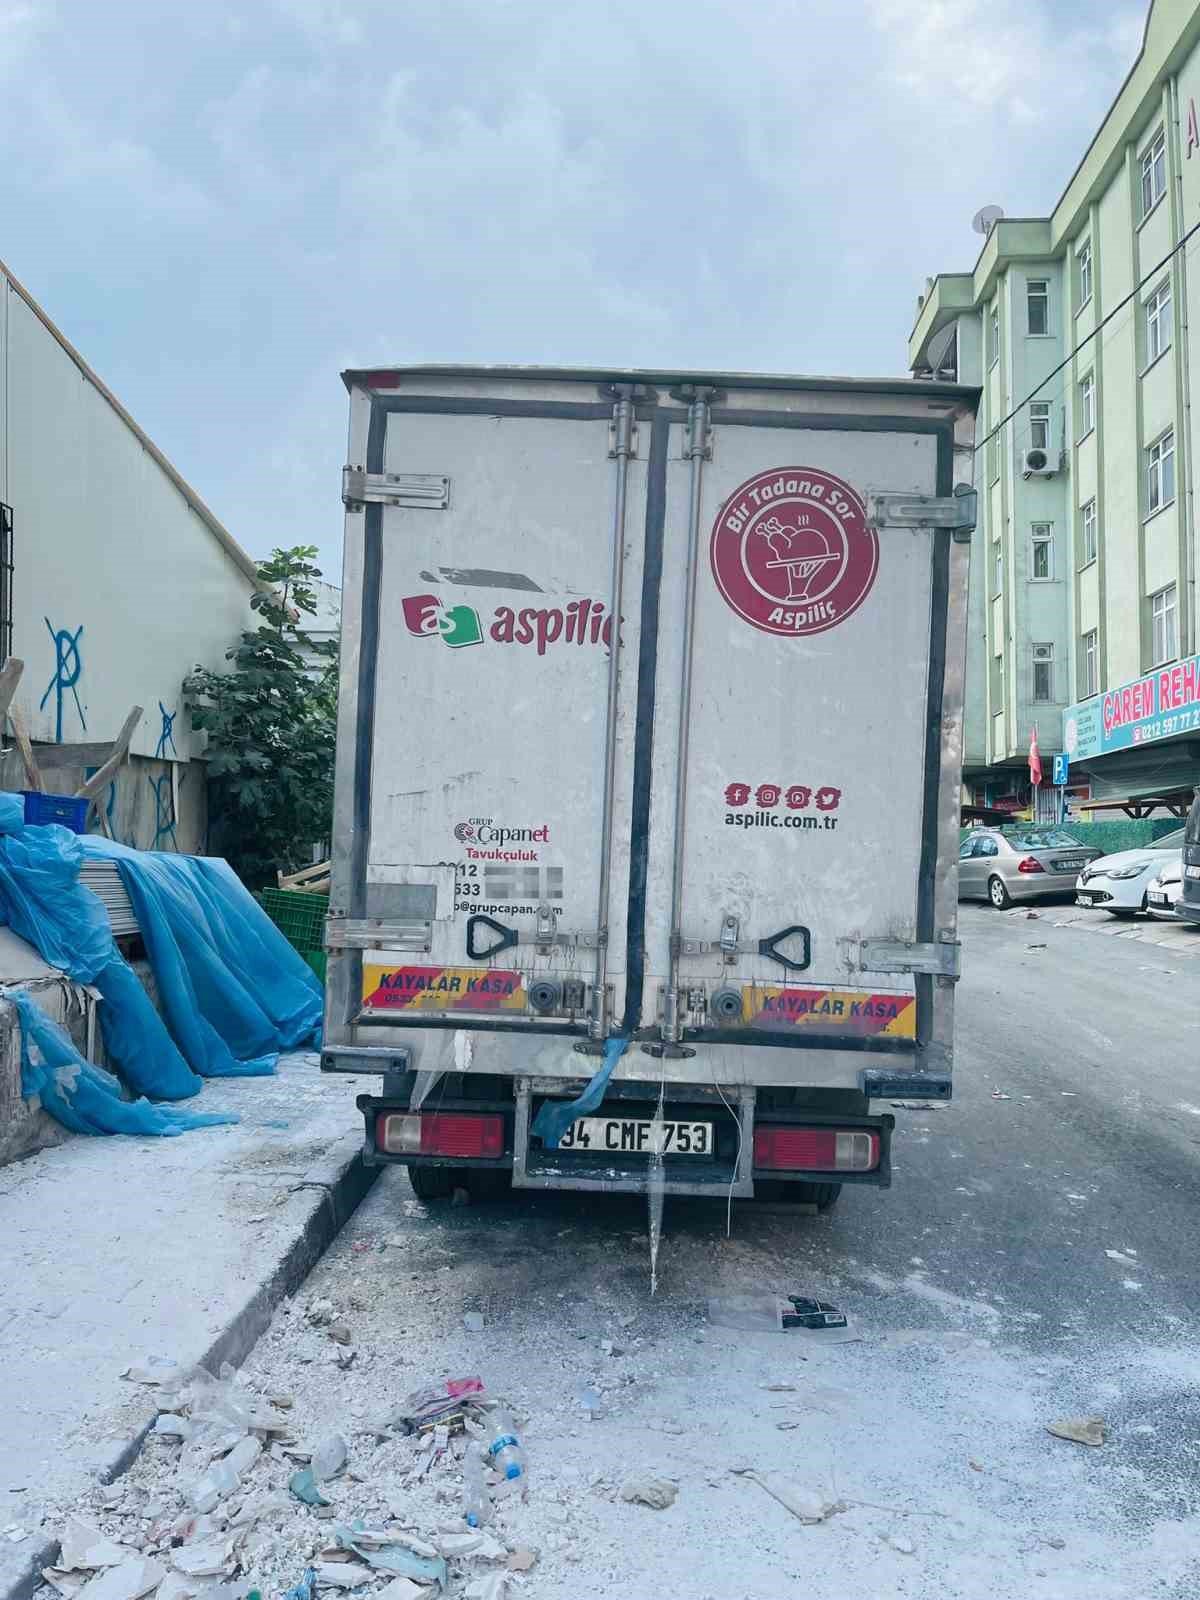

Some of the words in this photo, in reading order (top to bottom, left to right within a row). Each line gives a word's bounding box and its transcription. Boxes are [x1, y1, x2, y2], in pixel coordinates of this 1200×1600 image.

[726, 502, 751, 534] Bir
[748, 477, 825, 505] Tadana
[825, 490, 856, 521] Sor
[768, 600, 836, 629] Aspiliç
[1160, 661, 1200, 713] REH
[1055, 756, 1063, 780] P
[469, 818, 493, 826] GRUP
[725, 812, 838, 829] aspilic.com.tr
[466, 848, 538, 862] Tavukçuluk
[380, 974, 461, 992] KAYALAR
[467, 978, 513, 994] KASA
[763, 996, 844, 1015] KAYALAR
[850, 1001, 897, 1019] KASA
[606, 1122, 650, 1150] CMF
[663, 1124, 707, 1153] 753
